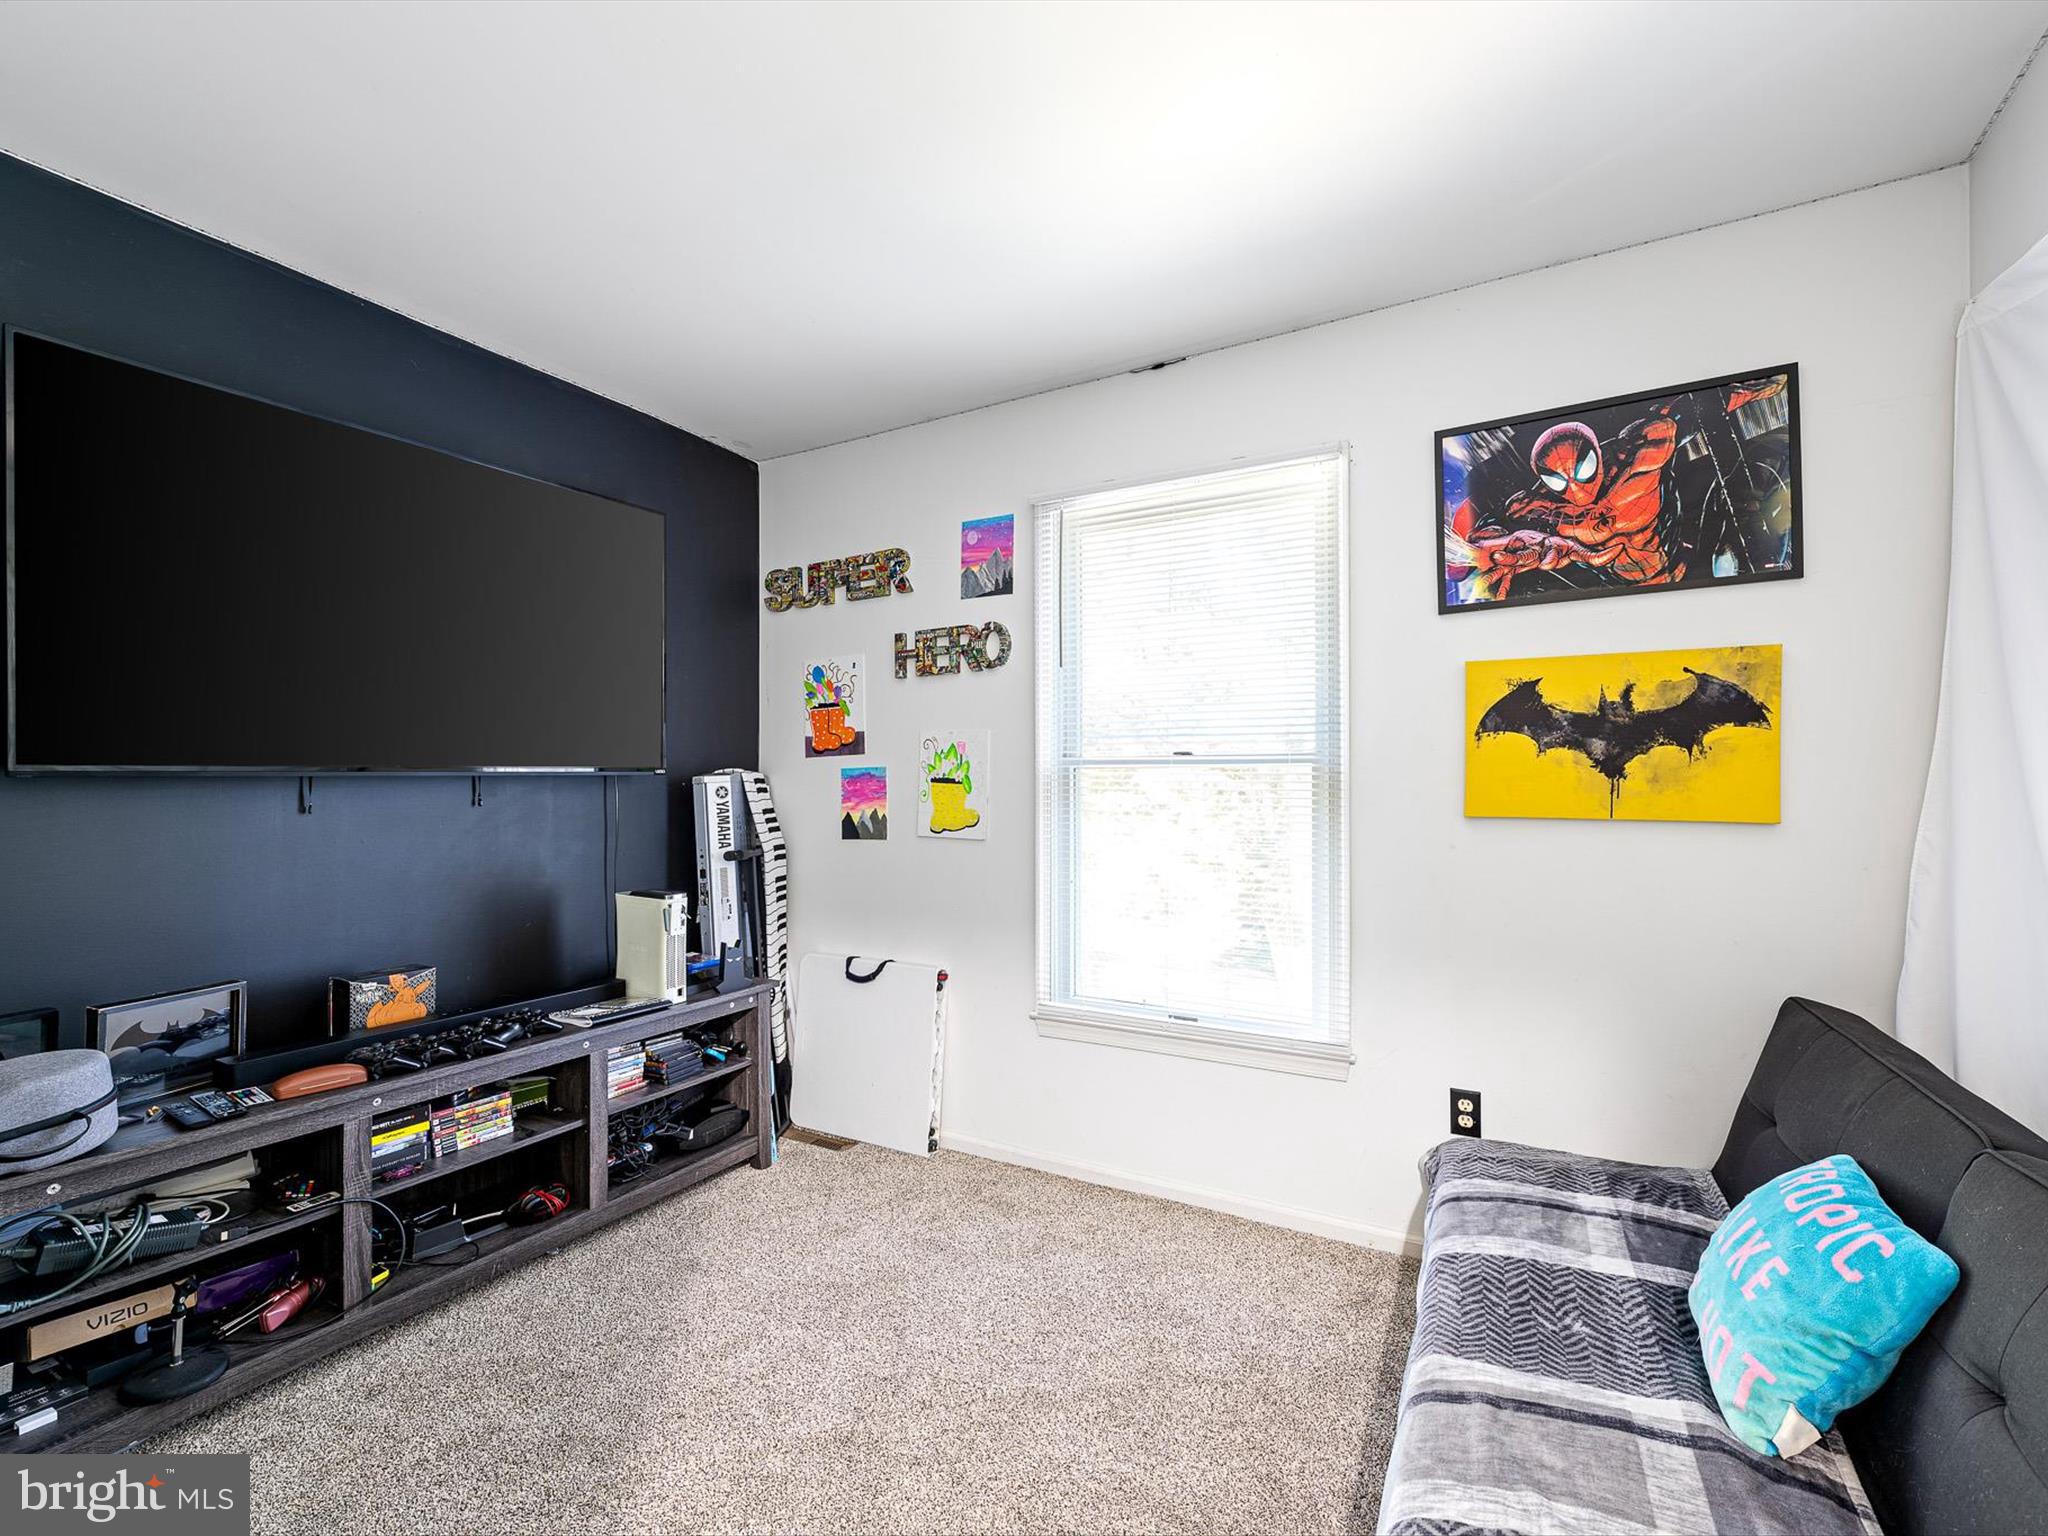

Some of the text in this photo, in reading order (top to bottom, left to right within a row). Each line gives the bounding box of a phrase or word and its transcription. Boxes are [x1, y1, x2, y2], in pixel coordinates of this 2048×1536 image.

[764, 548, 914, 612] SUPER
[895, 621, 1012, 679] HERO
[715, 800, 732, 850] YAMAHA
[86, 1302, 148, 1330] VIZIO
